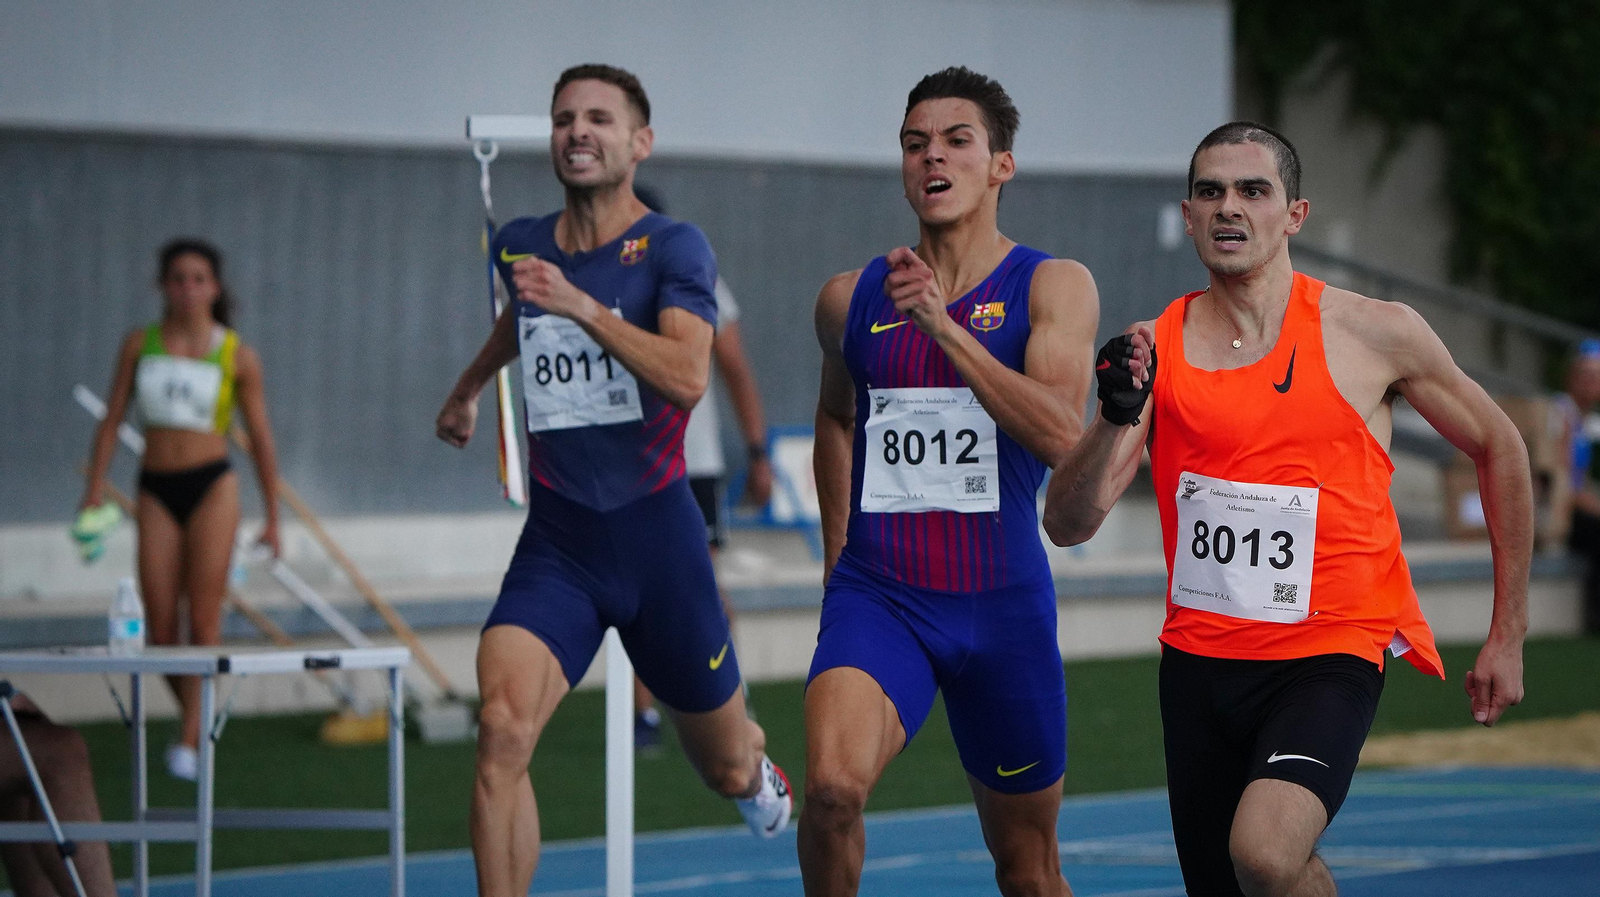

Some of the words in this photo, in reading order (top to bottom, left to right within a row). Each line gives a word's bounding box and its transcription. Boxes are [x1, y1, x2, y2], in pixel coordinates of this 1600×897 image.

[535, 349, 613, 385] 8011
[883, 428, 980, 465] 8012
[1209, 488, 1238, 499] Federación
[1240, 493, 1268, 502] Andaluza
[1226, 504, 1255, 513] Atletismo
[1191, 520, 1294, 570] 8013
[1178, 584, 1214, 598] Competiciones
[1215, 592, 1232, 602] F.A.A.
